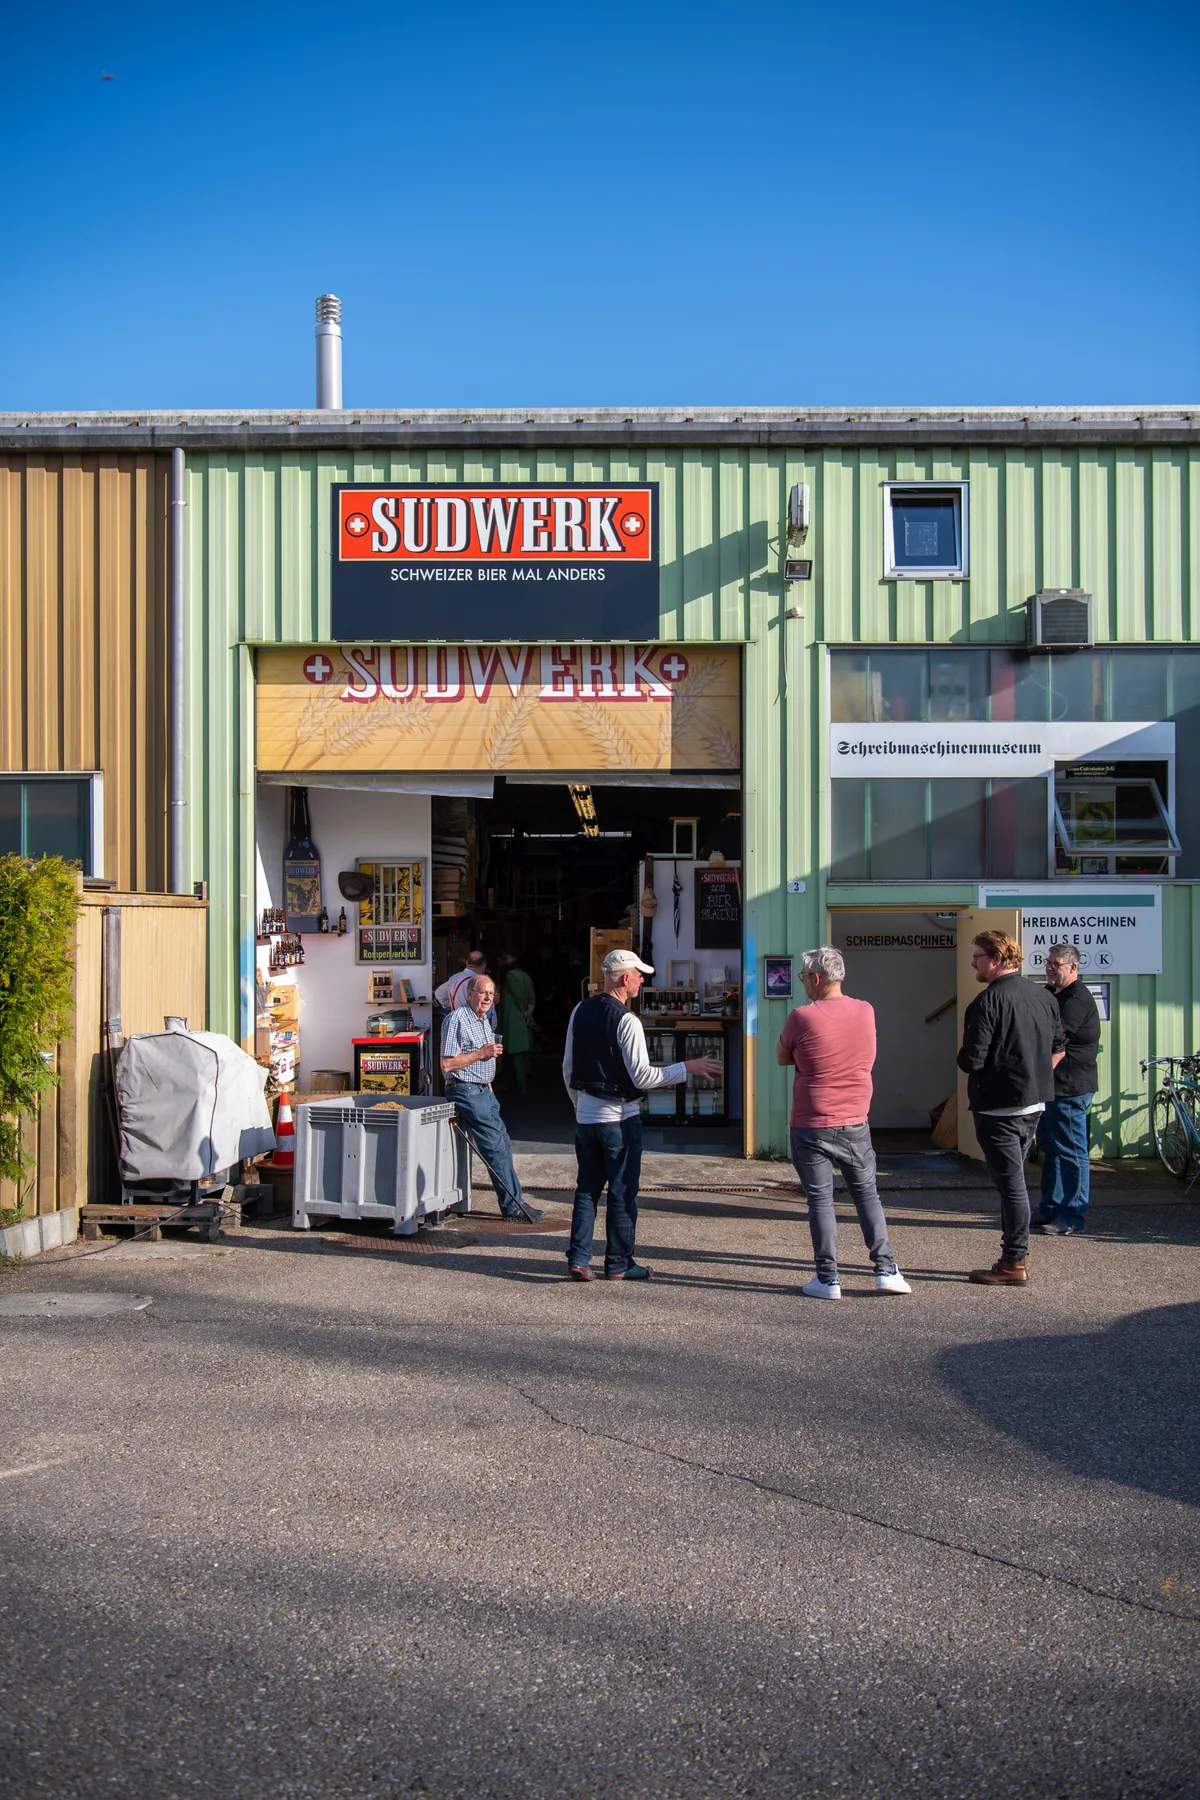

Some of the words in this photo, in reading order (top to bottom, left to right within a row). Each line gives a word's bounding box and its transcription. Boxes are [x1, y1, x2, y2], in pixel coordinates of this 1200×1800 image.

[371, 496, 625, 553] SUDWERK
[390, 568, 473, 581] SCHWEIZER
[478, 568, 507, 581] BIER
[512, 568, 543, 581] MAL
[546, 568, 606, 581] ANDERS
[340, 645, 674, 703] SUDWERK
[836, 741, 1042, 758] Schreibmaschinenmuseum
[794, 882, 799, 892] 3
[707, 894, 732, 908] BIER
[1022, 916, 1136, 928] HREIBMASCHINEN
[846, 935, 954, 947] SCHREIBMASCHINEN
[1033, 934, 1108, 945] MUSEUM
[363, 948, 417, 960] Rapenverkuf
[1033, 954, 1110, 965] BCK
[367, 1060, 403, 1070] SUDWERK
